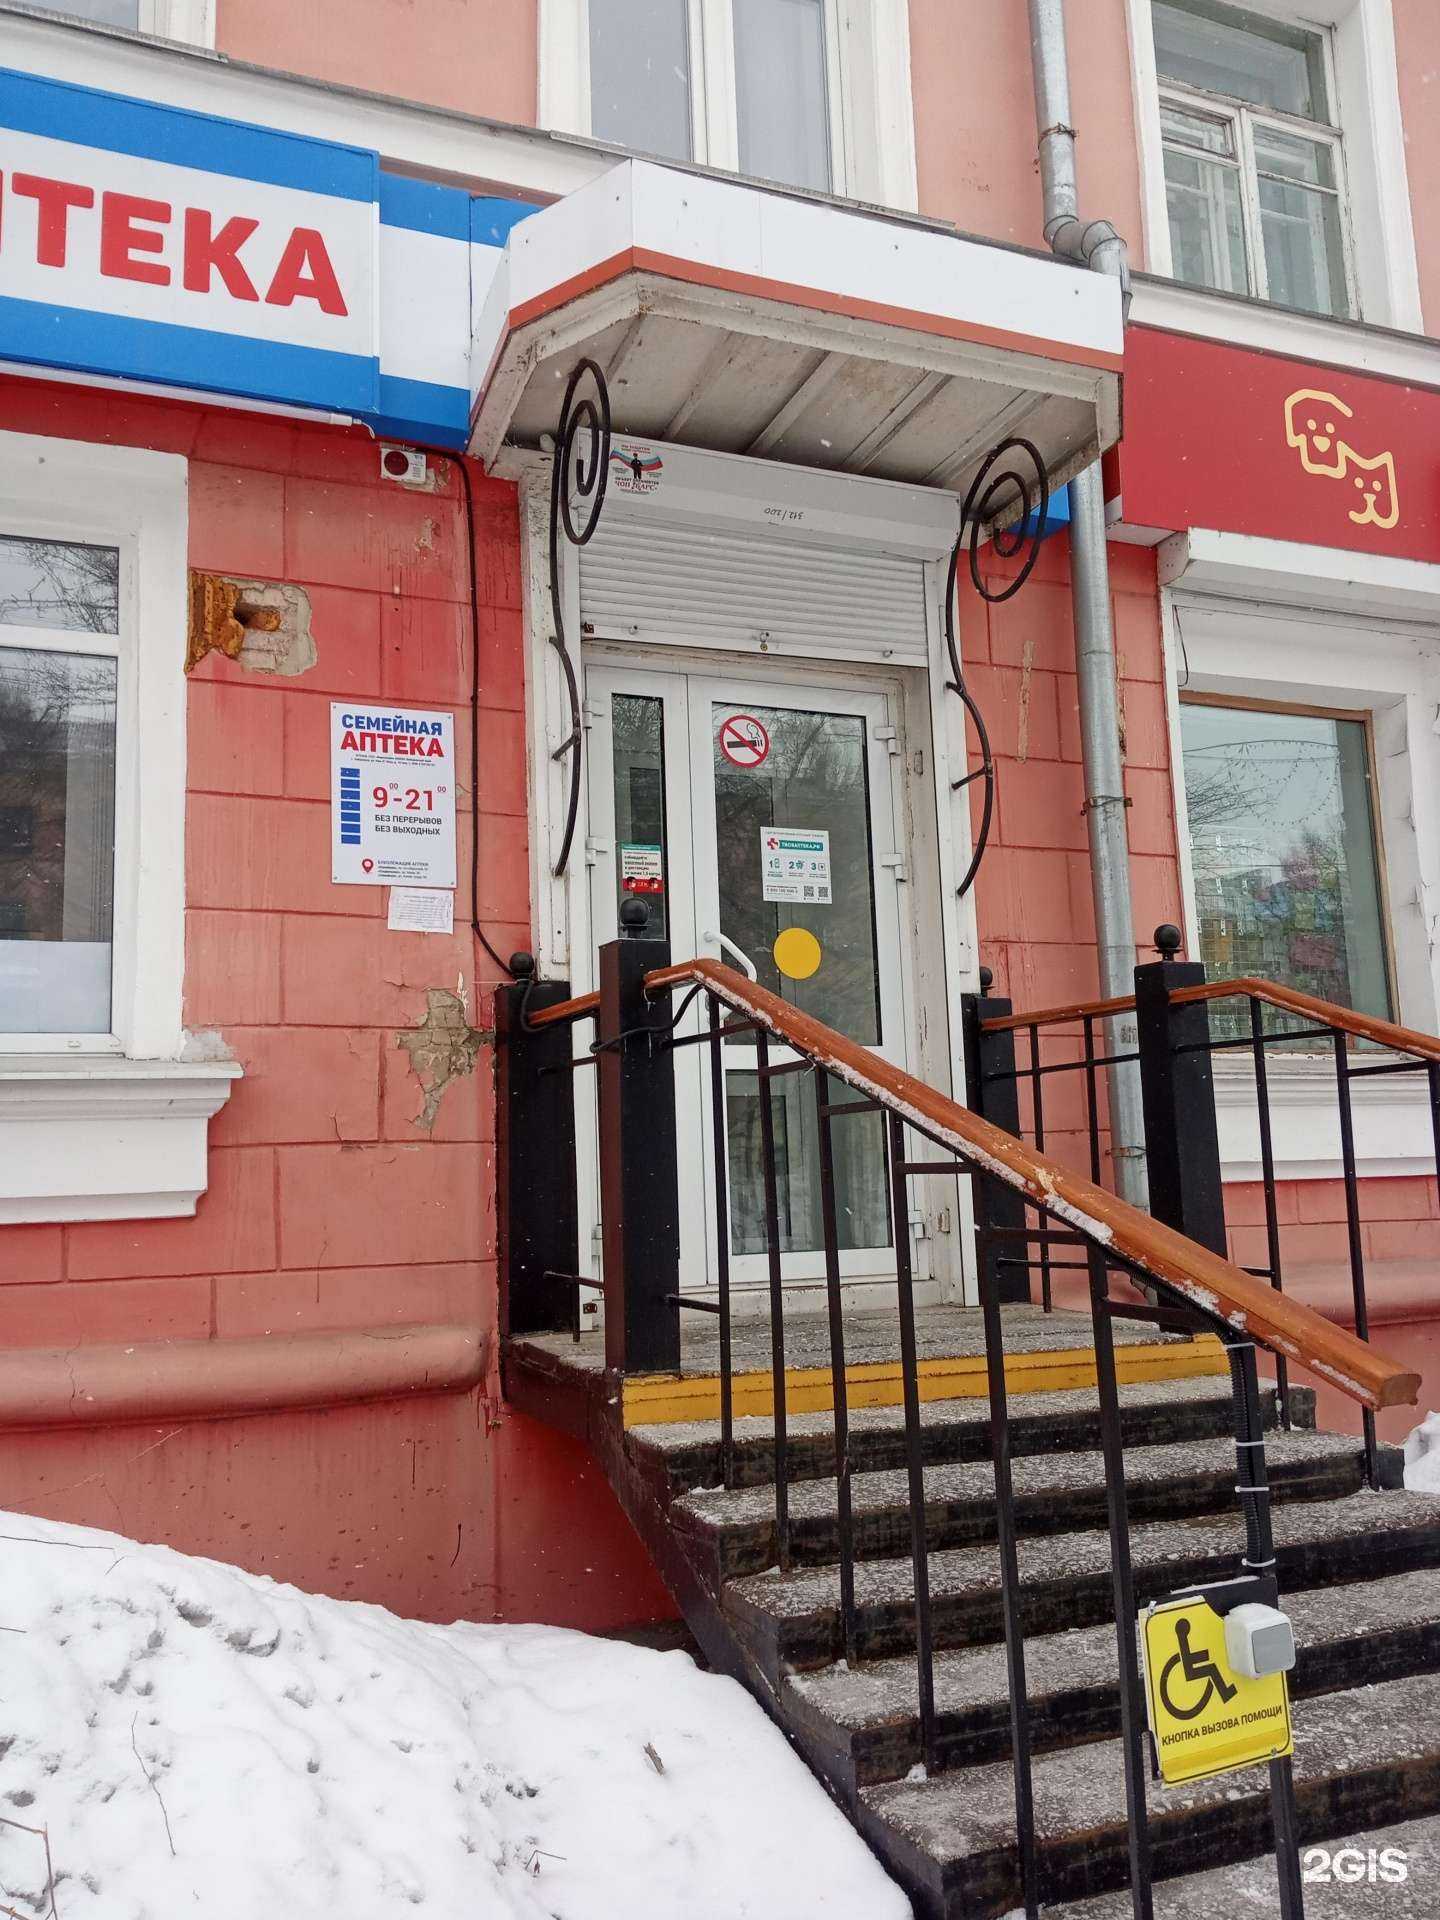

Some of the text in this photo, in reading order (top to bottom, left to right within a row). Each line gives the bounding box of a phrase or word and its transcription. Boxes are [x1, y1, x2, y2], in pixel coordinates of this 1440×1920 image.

[0, 168, 348, 316] ТЕКА
[342, 714, 442, 736] СЕМЕЙНАЯ
[341, 731, 444, 757] АПТЕКА
[375, 814, 442, 825] БЕЗ ПЕРЕРЫВОВ
[375, 824, 441, 836] БЕЗ ВЫХОДНЫХ
[769, 860, 817, 870] 1 2 3
[1161, 1705, 1283, 1746] КНОПКА ВЫЗОВА ПОМОЩИ
